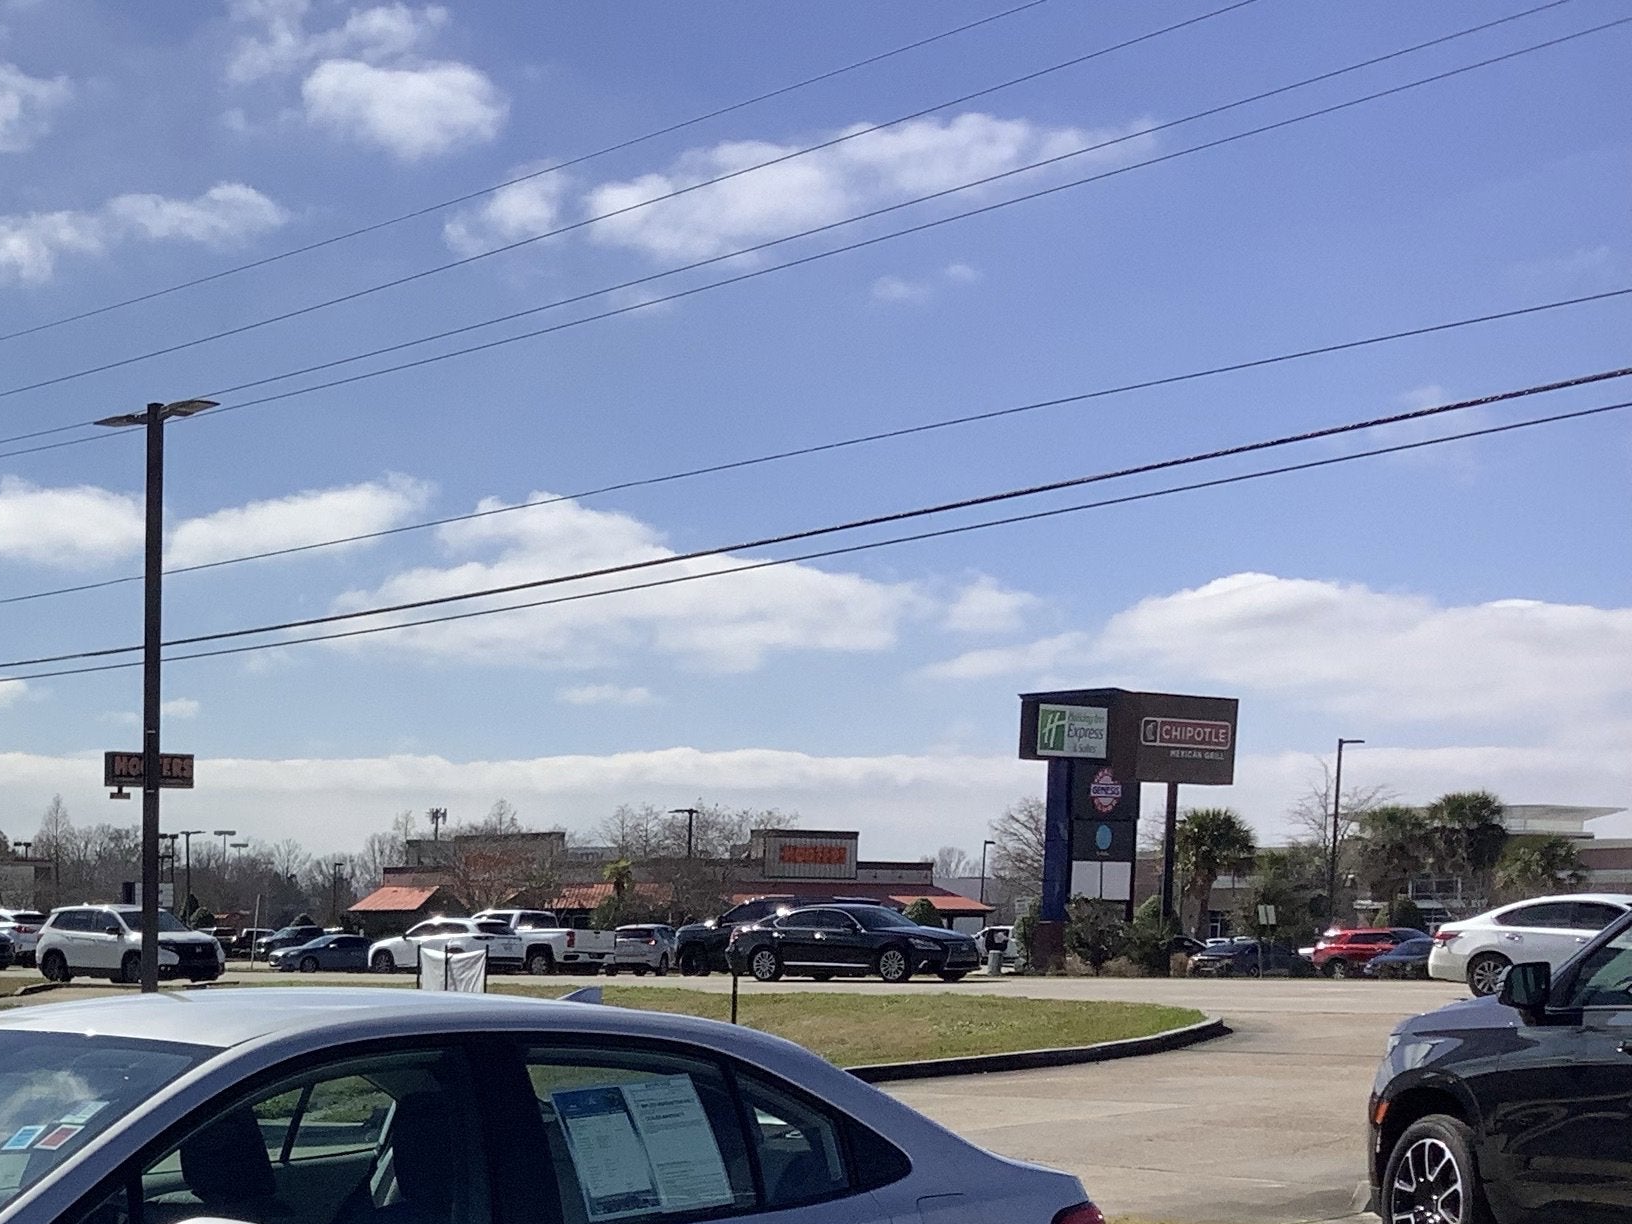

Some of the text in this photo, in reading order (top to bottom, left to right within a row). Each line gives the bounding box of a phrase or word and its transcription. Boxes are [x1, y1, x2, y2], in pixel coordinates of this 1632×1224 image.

[1068, 723, 1105, 742] Express
[1162, 724, 1227, 743] CHIPOTLE
[114, 755, 193, 778] HOERS
